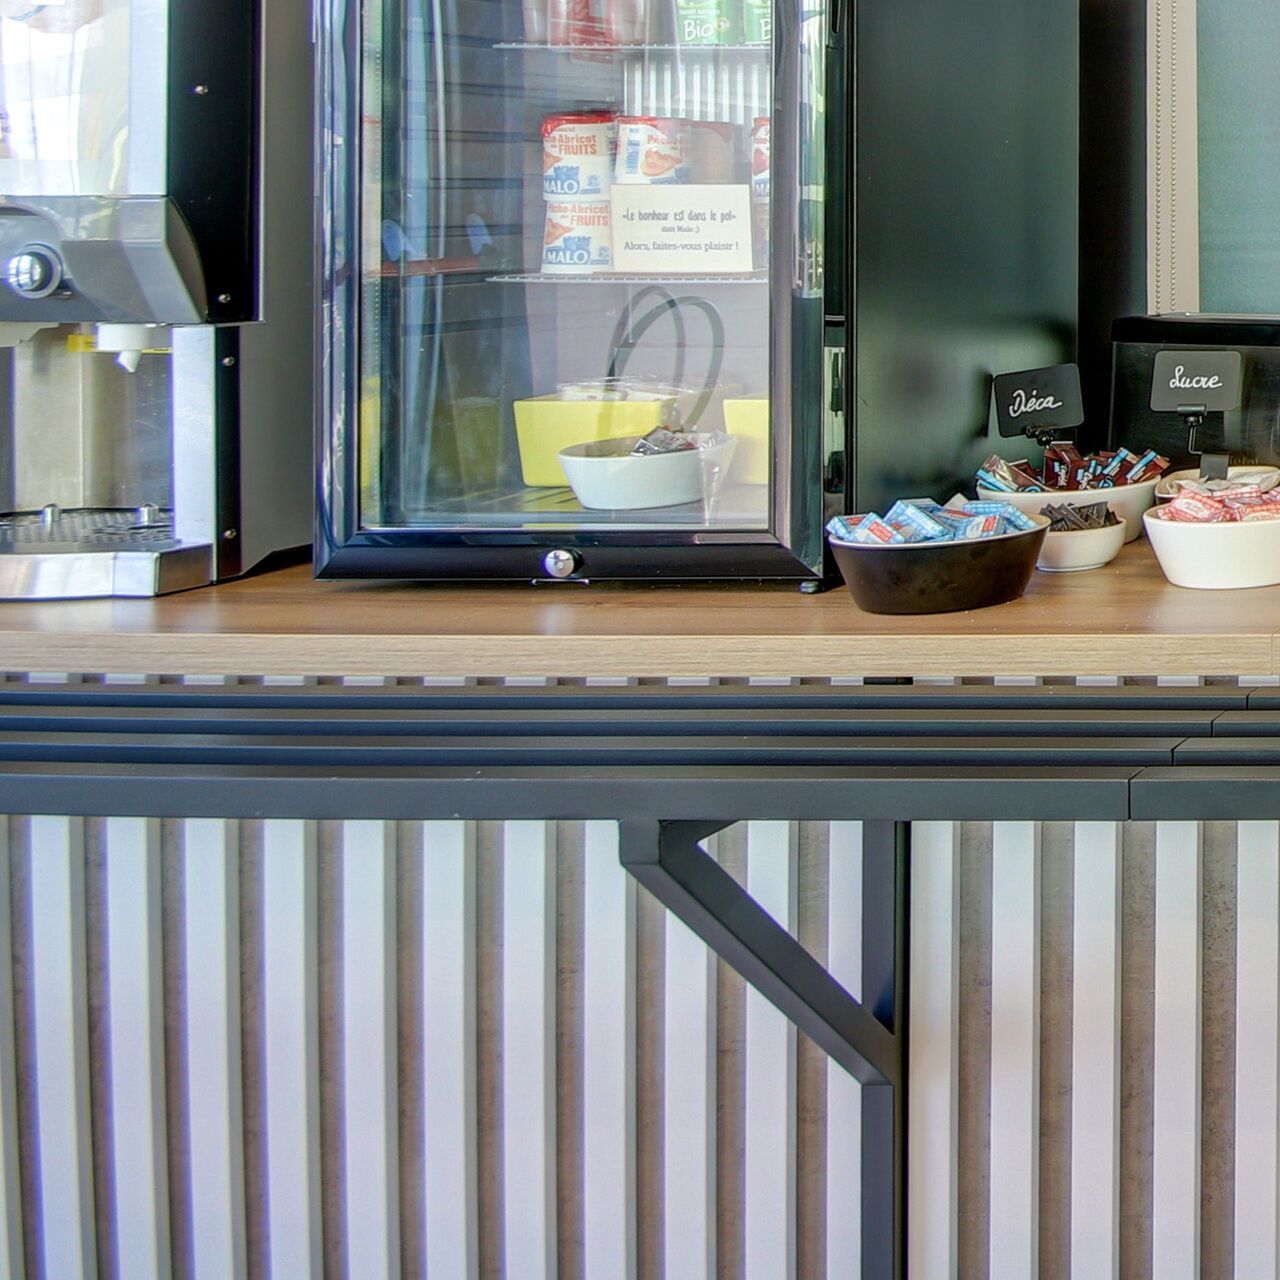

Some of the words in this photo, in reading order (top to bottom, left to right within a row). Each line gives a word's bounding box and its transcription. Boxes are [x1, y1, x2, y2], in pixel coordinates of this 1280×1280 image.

[684, 19, 714, 41] Bio
[559, 144, 597, 155] FRUITS
[570, 215, 608, 226] FRUITS
[638, 209, 669, 221] bonheur
[688, 209, 706, 221] dans
[710, 209, 716, 221] le
[624, 241, 650, 252] Alors,
[652, 241, 702, 251] faites-vous
[704, 241, 734, 253] plaisir
[547, 250, 588, 264] MALO
[1169, 364, 1223, 390] Sucre
[1008, 391, 1063, 416] Déca
